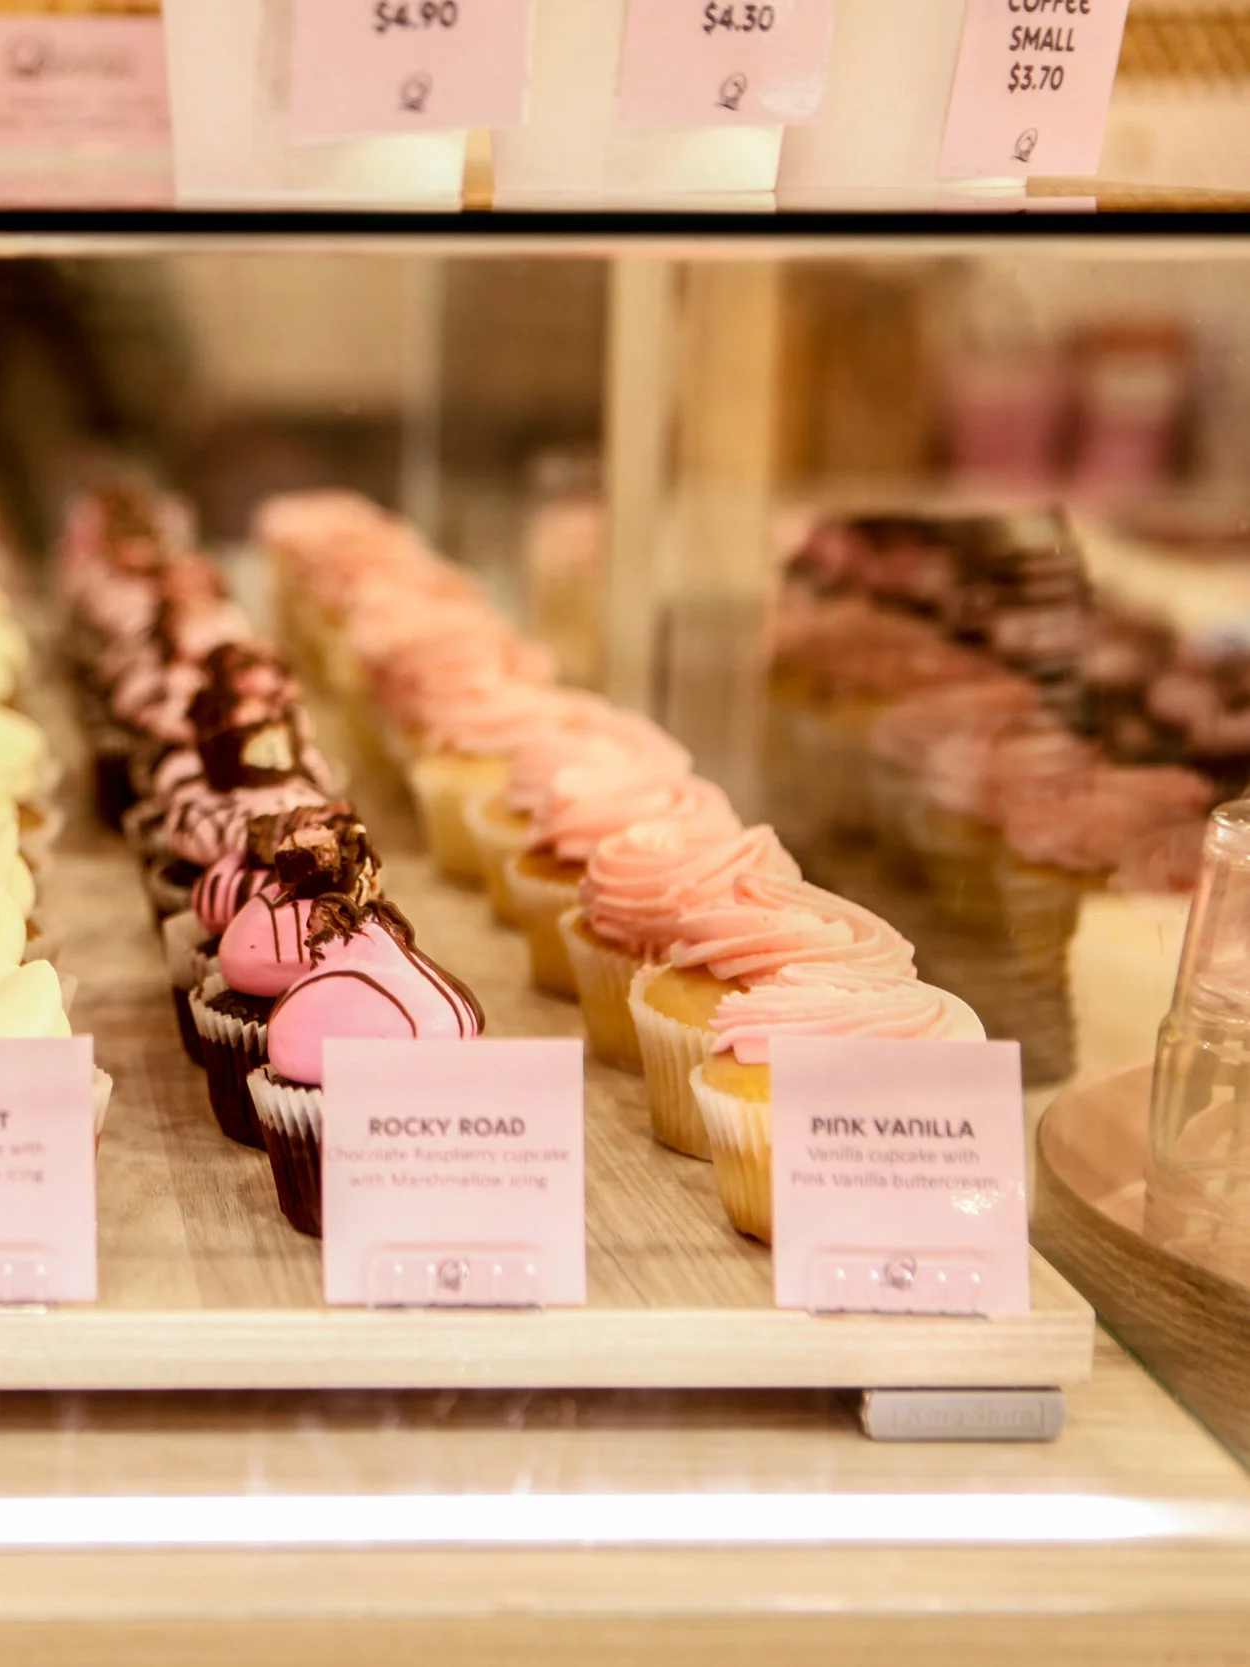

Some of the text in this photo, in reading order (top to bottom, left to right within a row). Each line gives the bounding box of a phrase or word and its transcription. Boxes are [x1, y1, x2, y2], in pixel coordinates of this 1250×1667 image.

[376, 0, 458, 34] $4.90
[703, 1, 775, 34] $4.30
[1009, 25, 1075, 51] SMALL
[1008, 62, 1065, 93] $3.70
[368, 1116, 526, 1137] ROCKY ROAD
[811, 1115, 976, 1139] PINK VANILLA
[806, 1146, 980, 1166] Vanilla cupcake with
[791, 1171, 999, 1192] Pink Vanilla buttercream
